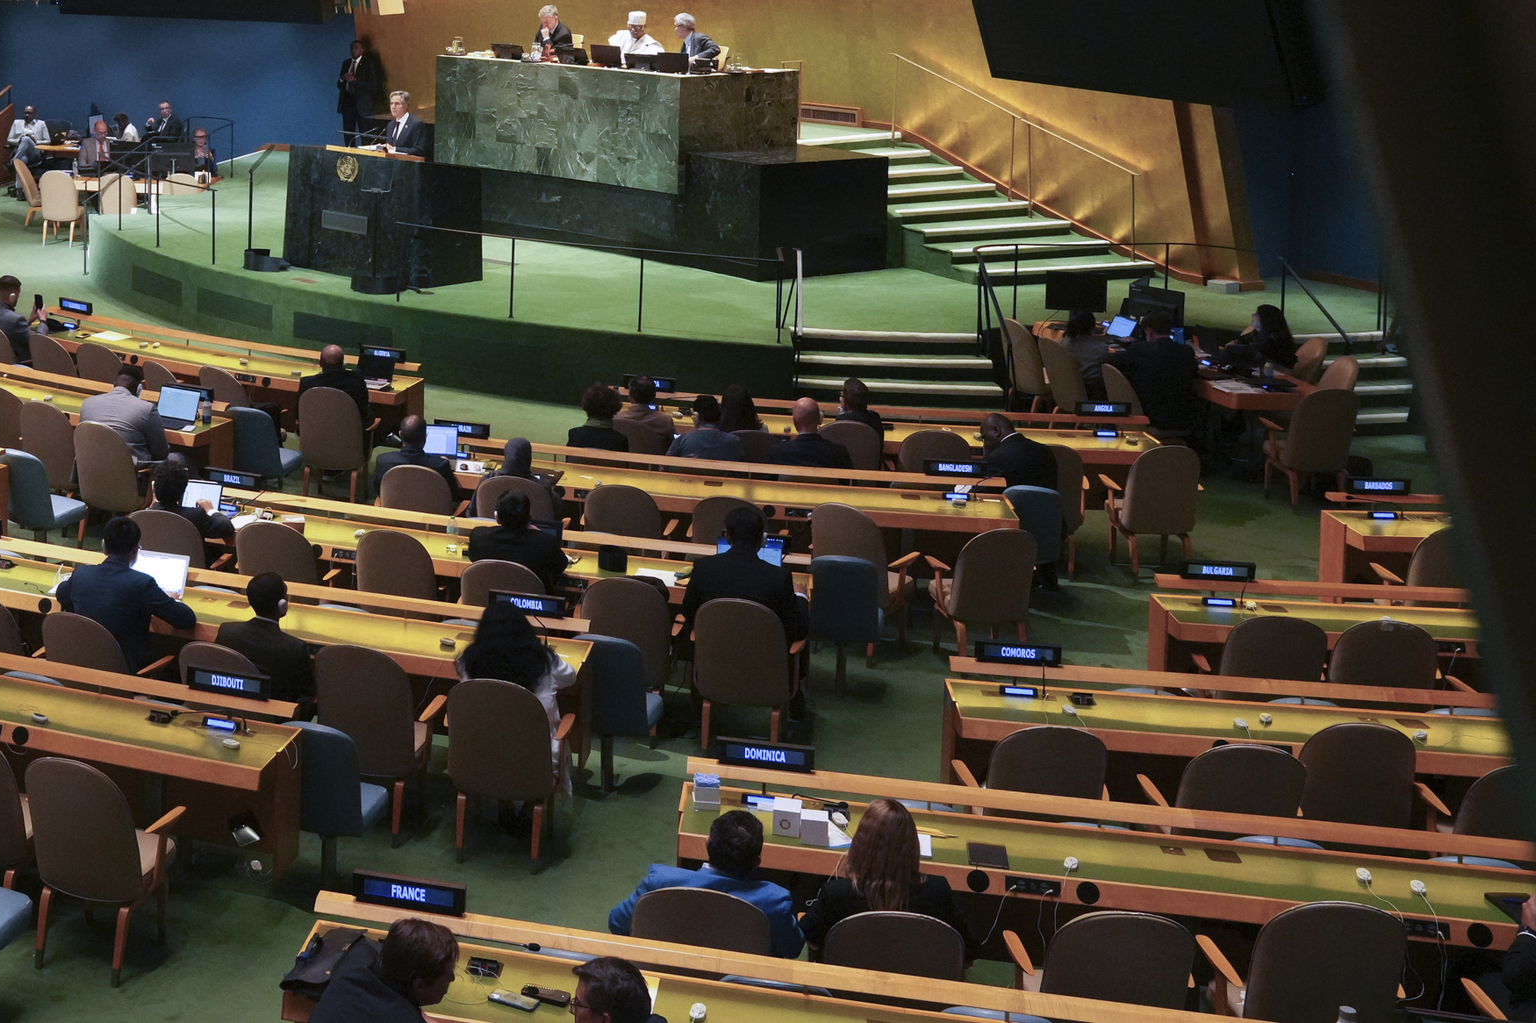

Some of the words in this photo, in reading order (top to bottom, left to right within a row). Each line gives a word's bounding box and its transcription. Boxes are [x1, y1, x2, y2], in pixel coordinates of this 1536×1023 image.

[1094, 404, 1114, 413] ANGOLA
[939, 463, 973, 473] BANGLADESH
[223, 474, 241, 485] BRAZIL
[1364, 481, 1393, 490] BARBADOS
[1202, 566, 1233, 576] BULGARIA
[1001, 646, 1036, 659] COMOROS
[211, 674, 243, 690] DJIBOUTI
[744, 747, 786, 763] DOMINICA
[391, 884, 426, 902] FRANCE
